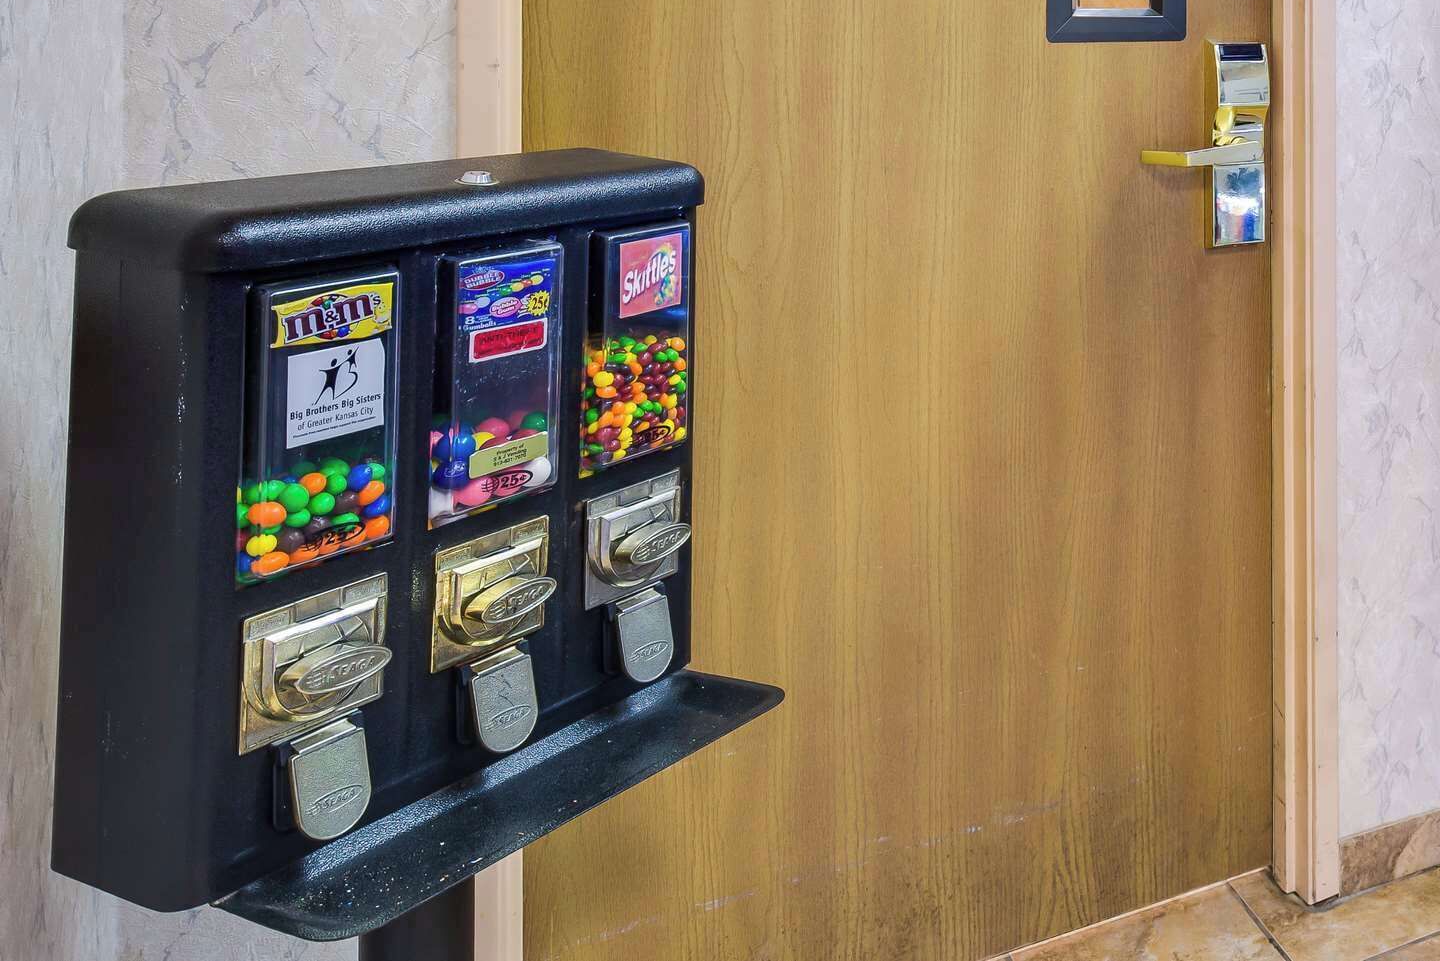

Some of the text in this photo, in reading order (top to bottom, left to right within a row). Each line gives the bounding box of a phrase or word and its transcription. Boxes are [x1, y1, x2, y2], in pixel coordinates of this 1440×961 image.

[622, 250, 676, 304] Skittles
[464, 315, 475, 325] 8
[290, 392, 381, 421] Big Brothers Big Sisters
[297, 422, 305, 431] of
[307, 416, 333, 429] Greater
[335, 410, 358, 422] Kansas
[360, 406, 374, 418] City
[501, 473, 527, 488] 25¢
[331, 655, 376, 676] SEAGA
